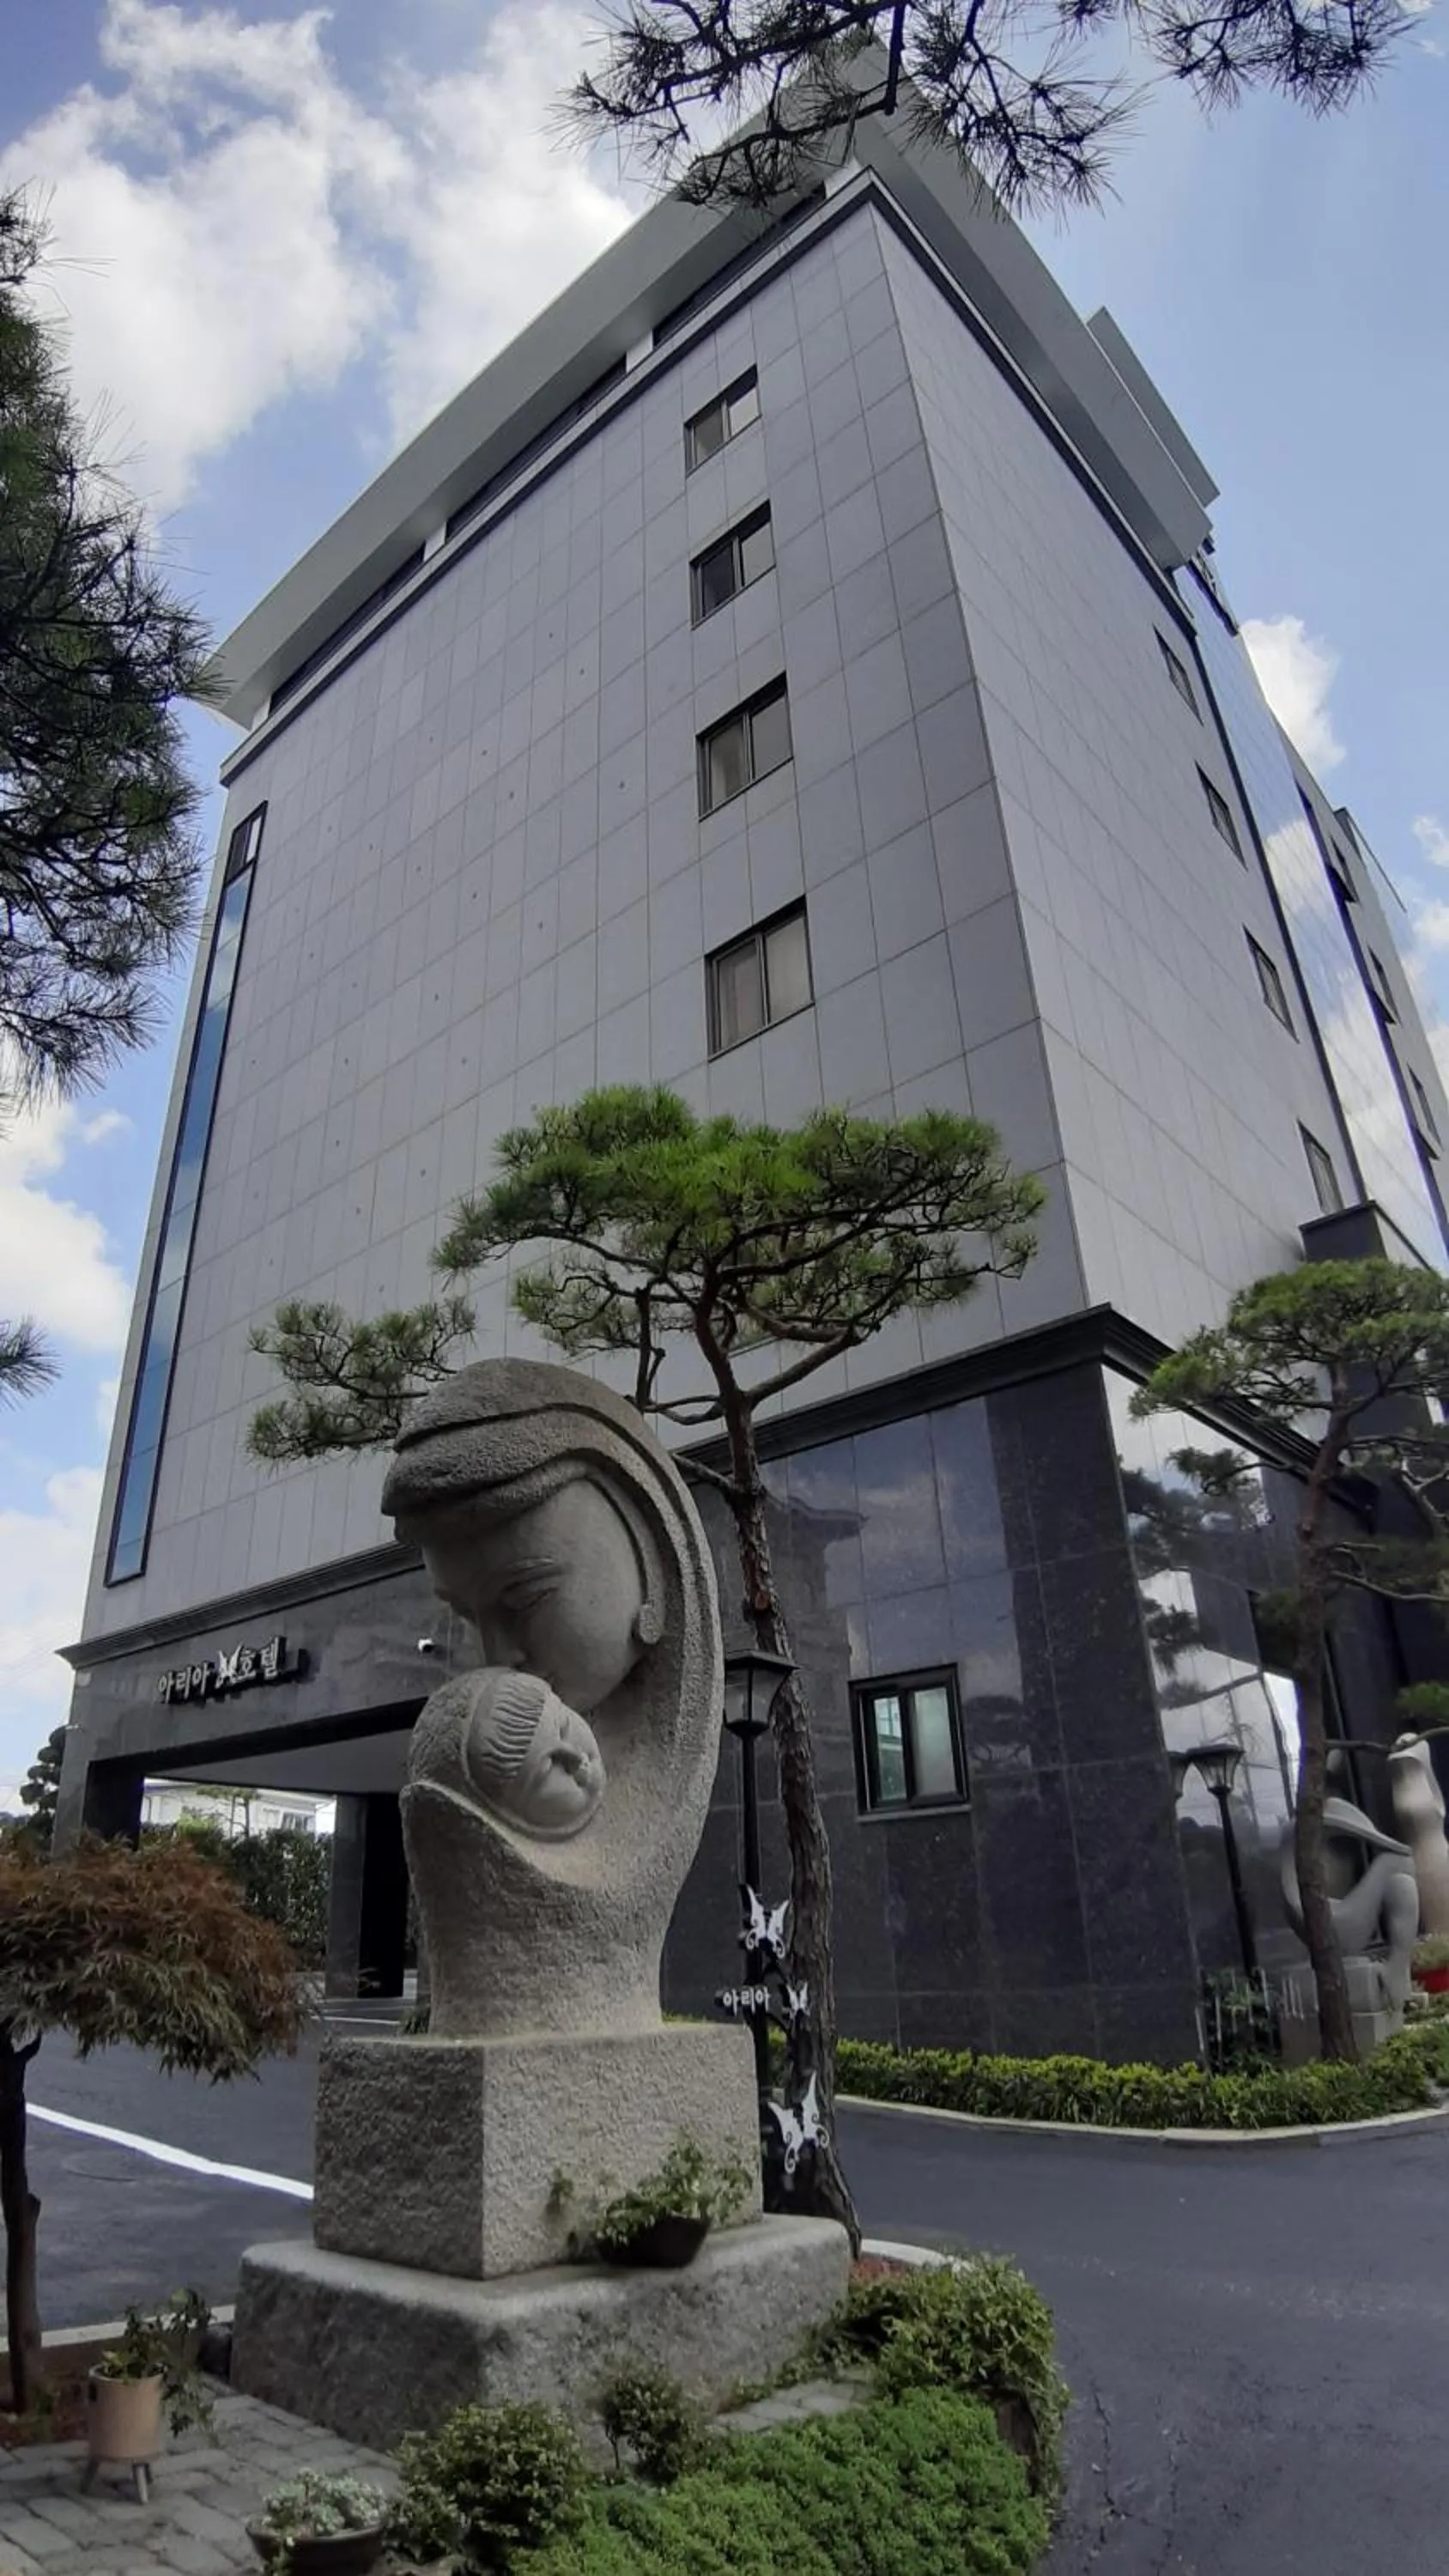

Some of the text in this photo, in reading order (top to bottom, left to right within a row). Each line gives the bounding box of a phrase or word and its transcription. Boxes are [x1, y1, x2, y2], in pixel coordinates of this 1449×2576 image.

[157, 1636, 280, 1704] 아리아 호텔
[722, 1986, 771, 2016] 아리아
